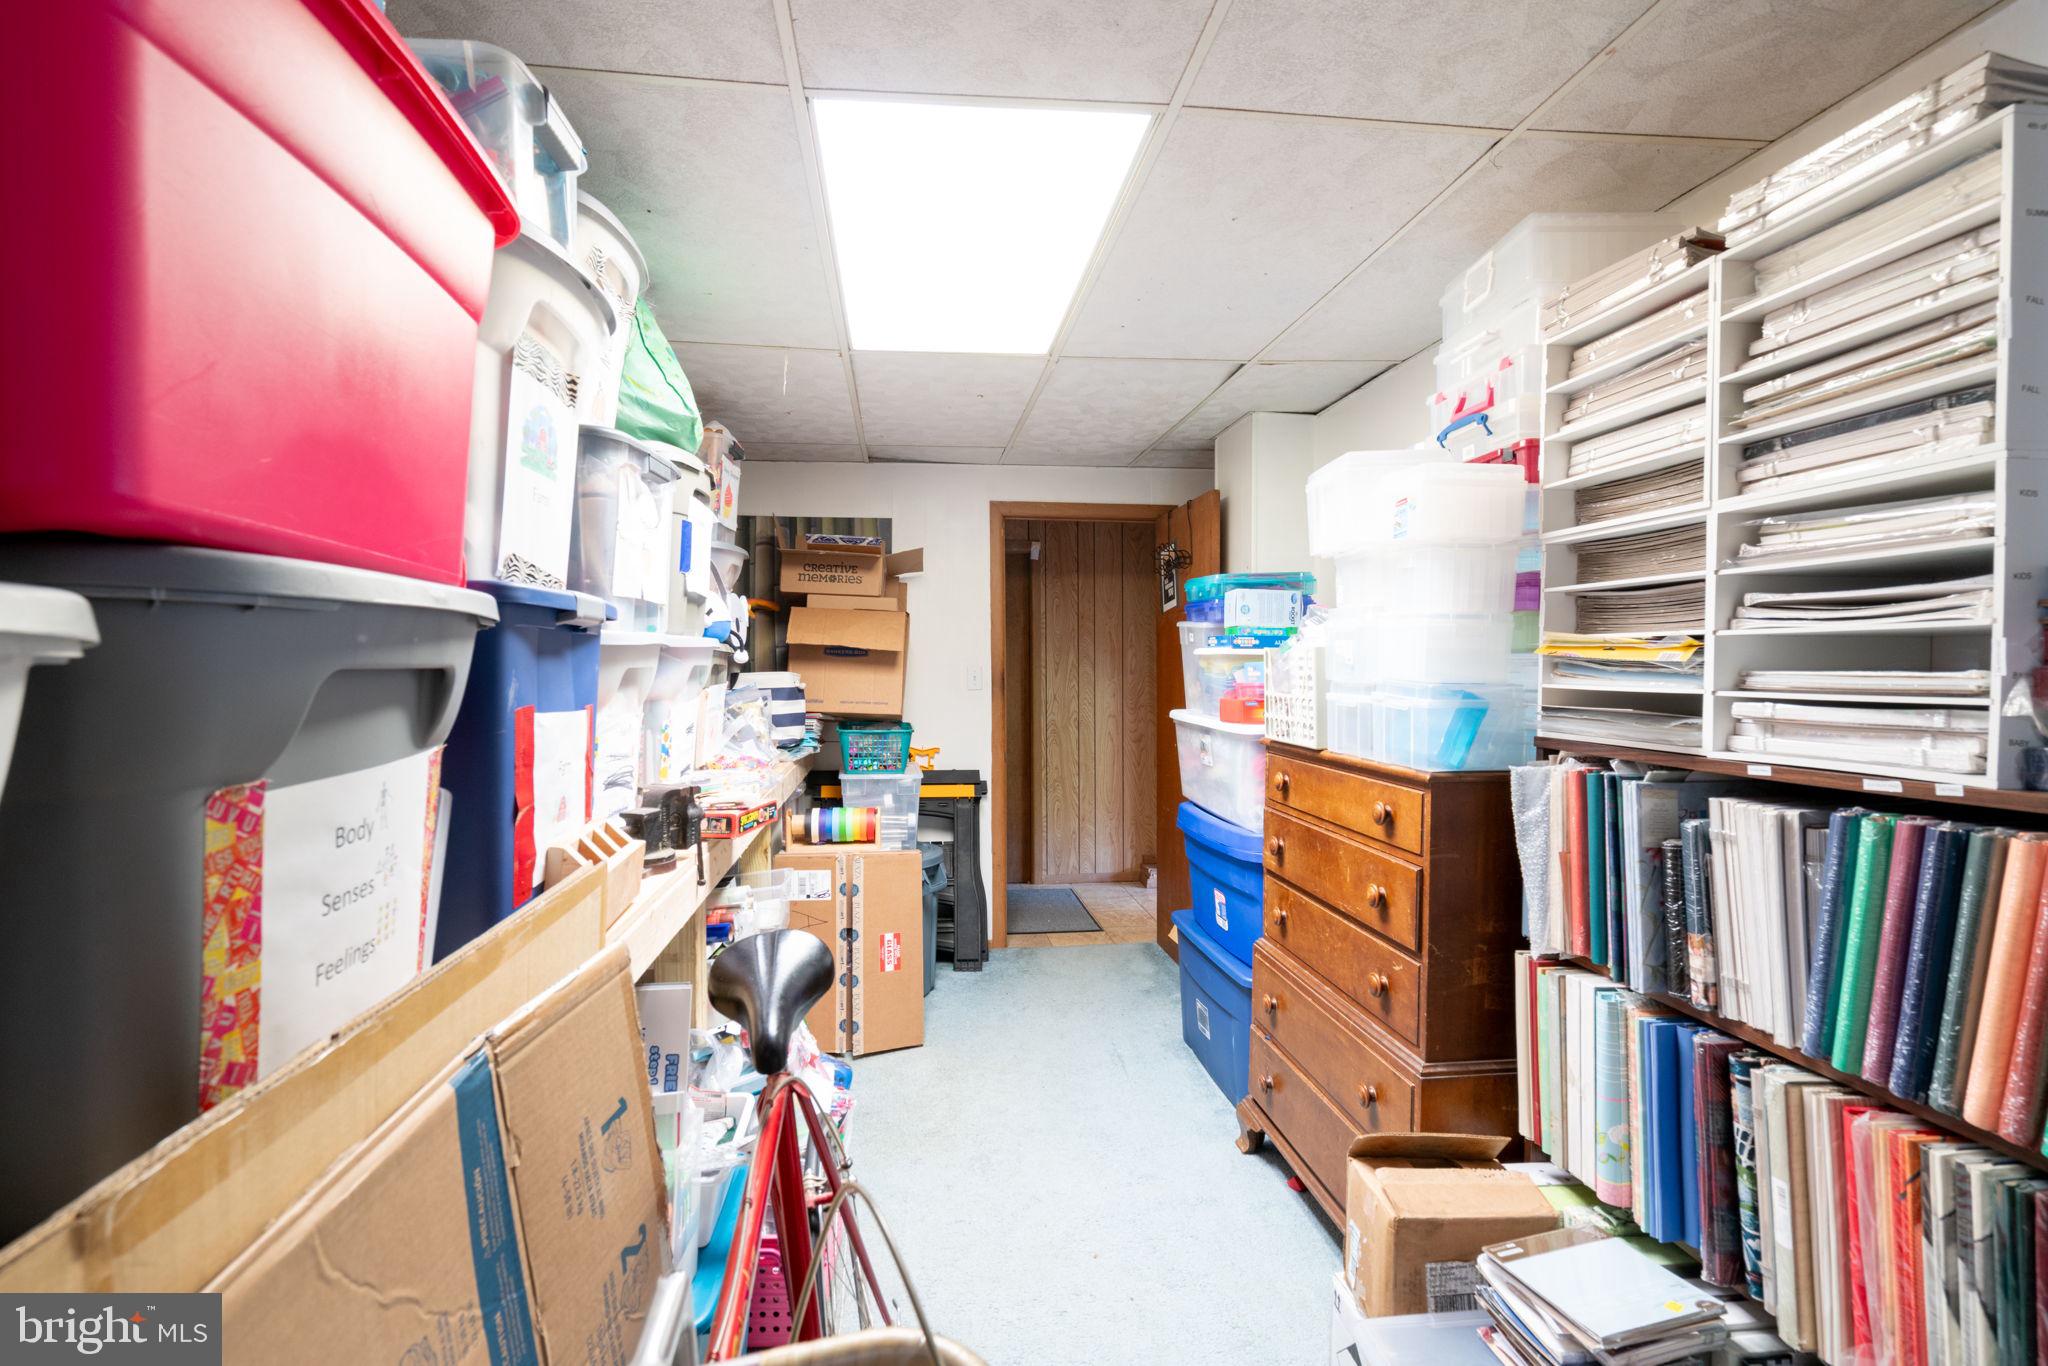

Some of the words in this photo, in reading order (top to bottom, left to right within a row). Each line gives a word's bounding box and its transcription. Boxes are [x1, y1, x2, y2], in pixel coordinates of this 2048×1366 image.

[2025, 295, 2046, 306] FALL
[2021, 384, 2041, 395] FALL
[2019, 489, 2039, 498] KIDS
[2013, 572, 2033, 580] KIDS
[335, 817, 375, 849] Body
[321, 878, 375, 918] Senses
[314, 937, 377, 988] Feelings
[648, 1045, 661, 1078] step
